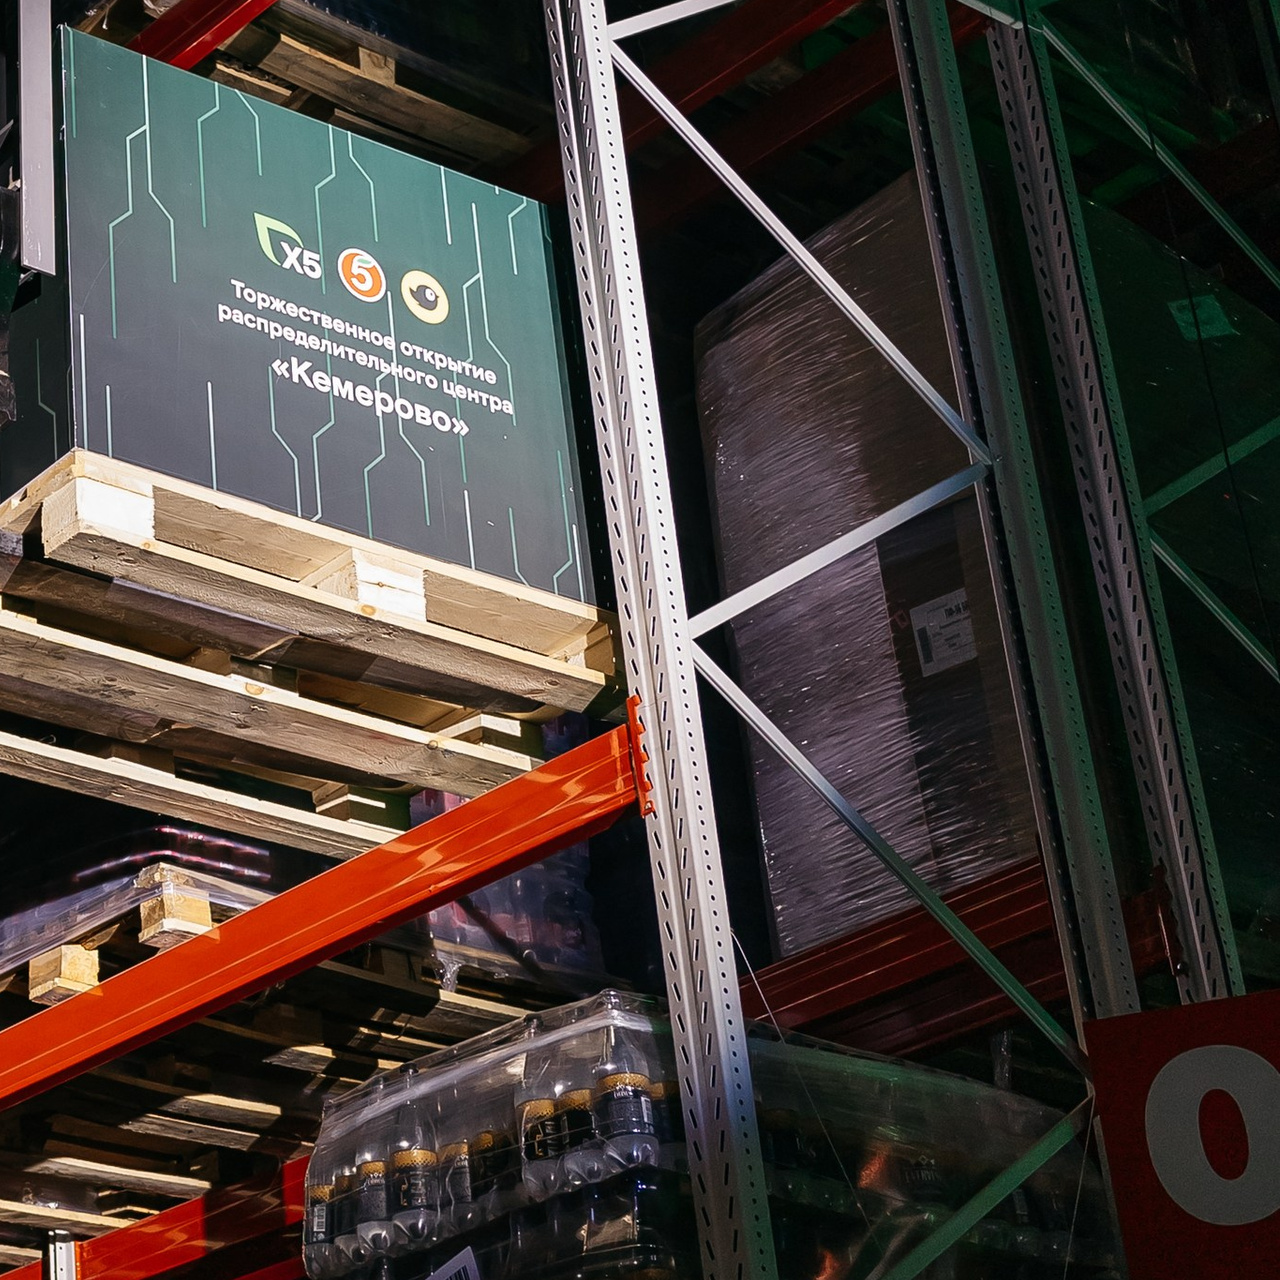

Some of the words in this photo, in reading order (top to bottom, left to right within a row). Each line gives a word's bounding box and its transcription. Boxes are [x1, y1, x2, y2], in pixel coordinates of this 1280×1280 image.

[218, 303, 439, 390] распределительного
[442, 379, 515, 416] центра
[230, 278, 395, 351] Торжественное
[400, 340, 498, 385] открытие
[271, 356, 470, 437] «Кемерово»
